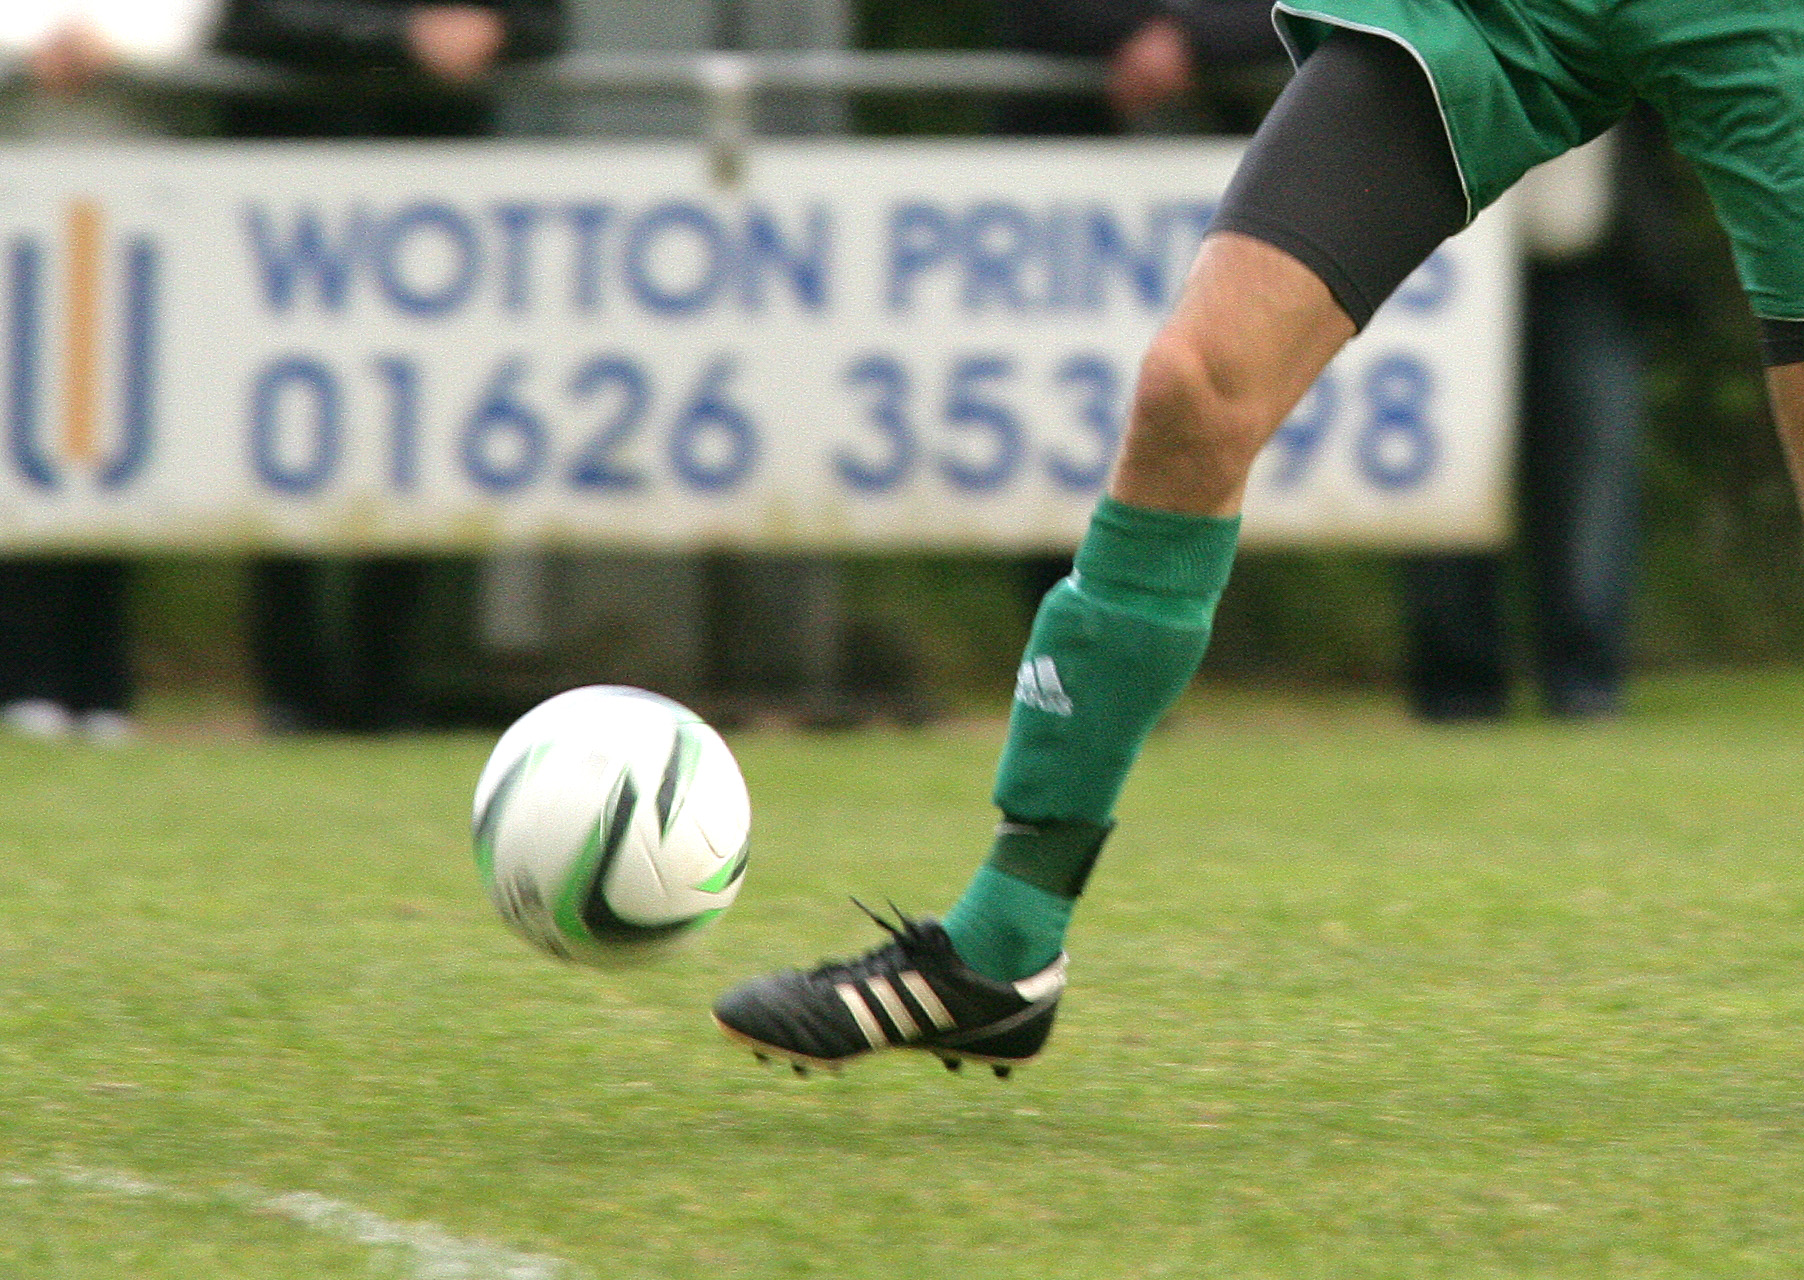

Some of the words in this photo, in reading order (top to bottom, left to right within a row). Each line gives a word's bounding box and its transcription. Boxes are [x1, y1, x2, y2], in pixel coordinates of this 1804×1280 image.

[240, 198, 830, 316] WOTTON
[248, 354, 764, 496] 01626
[832, 354, 1444, 496] 35398
